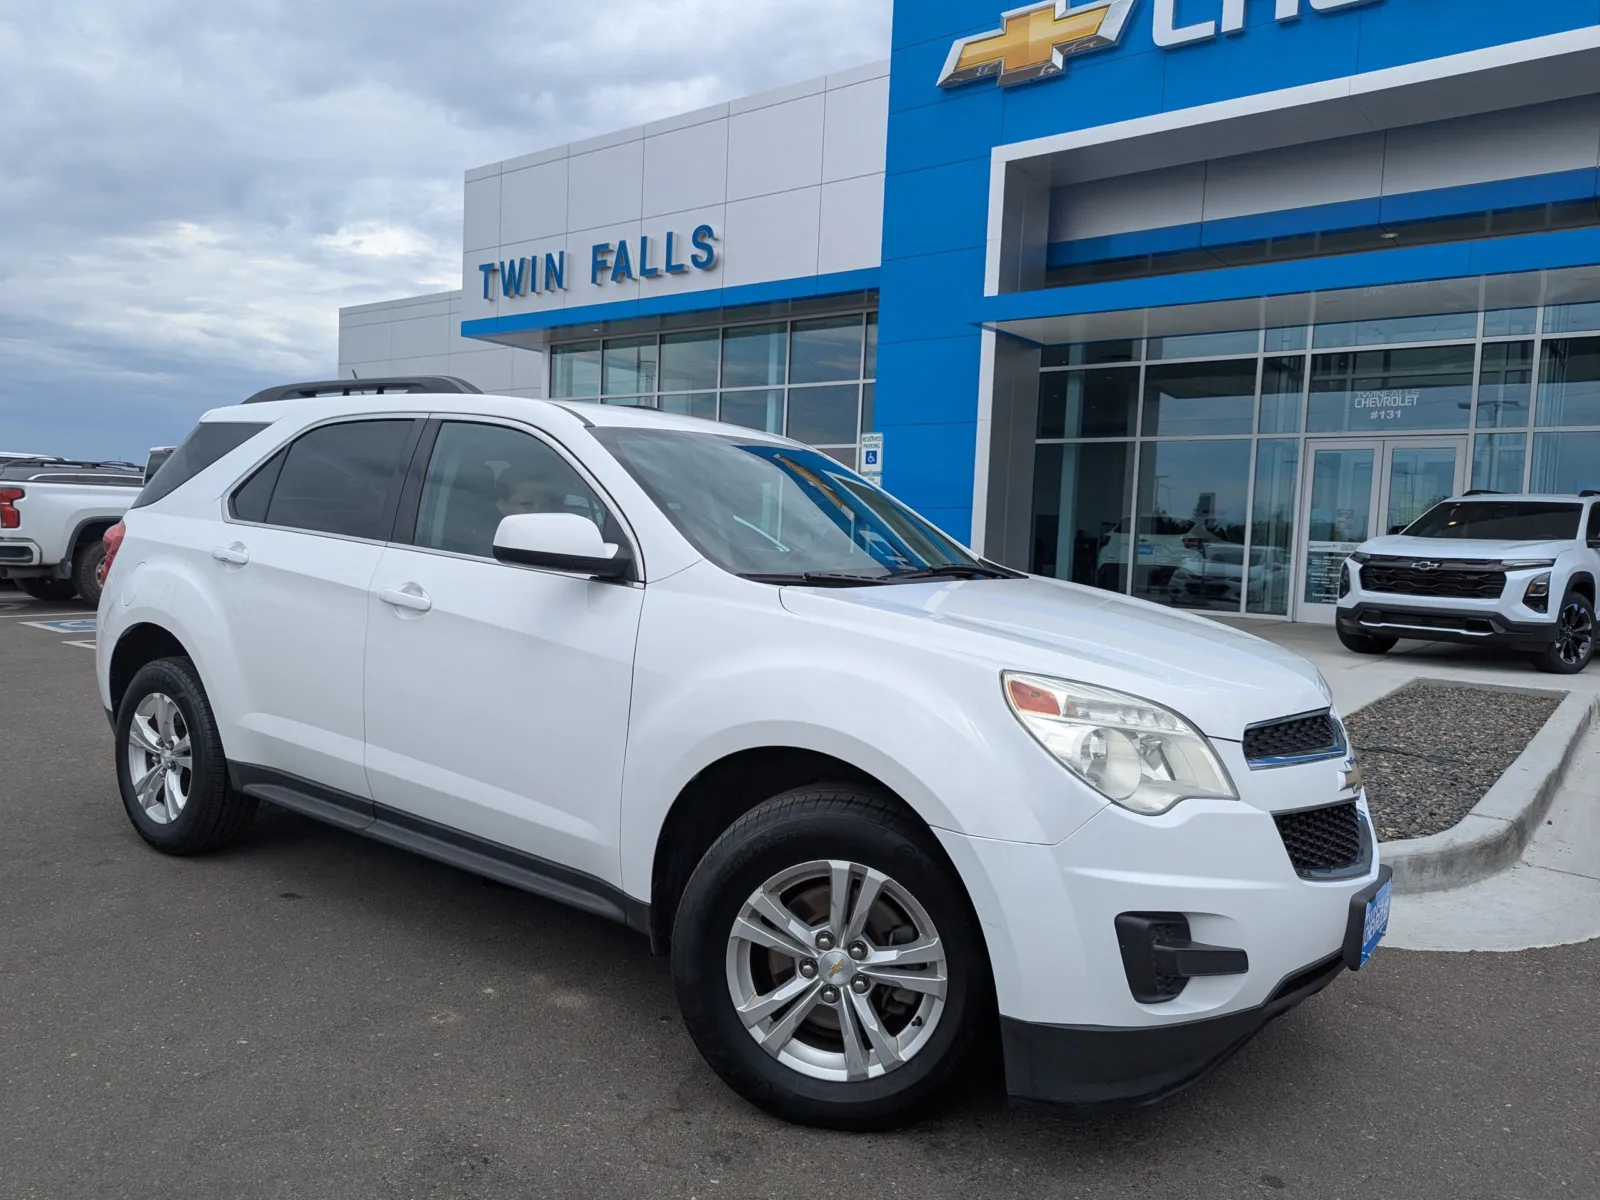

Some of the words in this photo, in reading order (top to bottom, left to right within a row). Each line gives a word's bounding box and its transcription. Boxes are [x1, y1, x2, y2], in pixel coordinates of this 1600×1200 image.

[479, 250, 568, 301] TWIN
[591, 224, 718, 286] FALLS
[1354, 395, 1418, 408] CHEVROLET
[1369, 409, 1402, 420] #131
